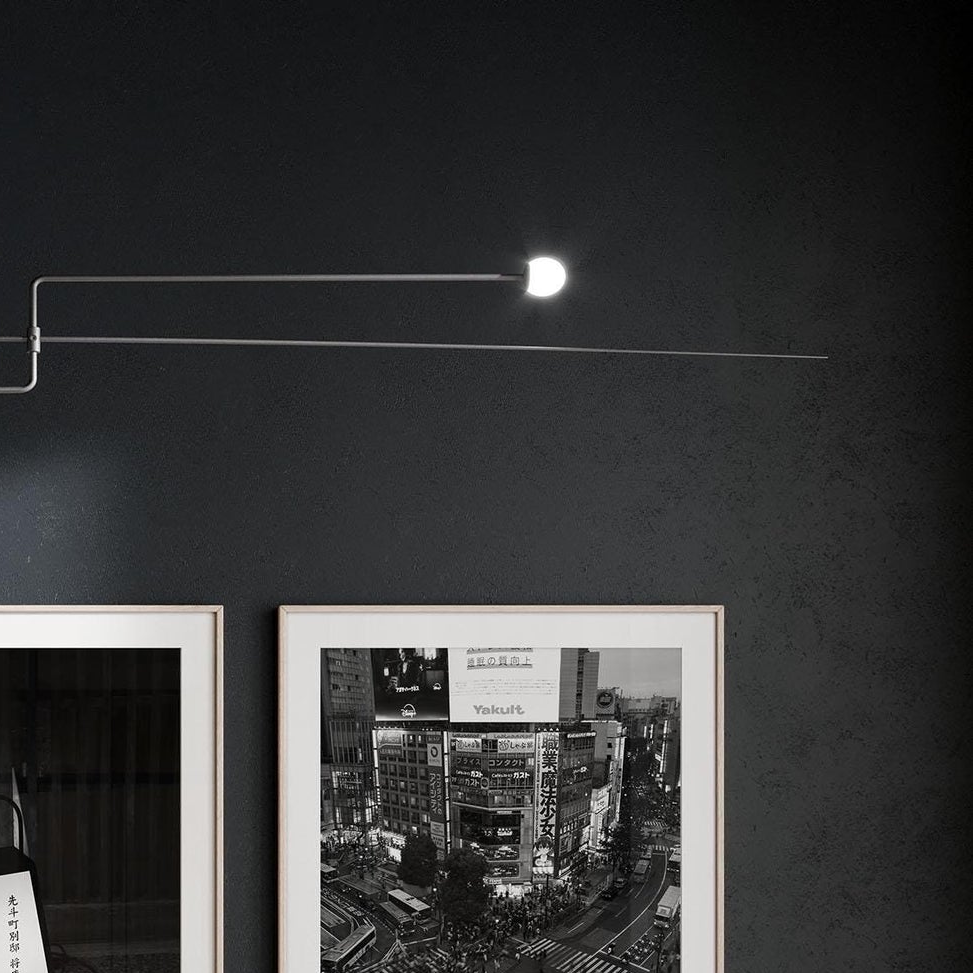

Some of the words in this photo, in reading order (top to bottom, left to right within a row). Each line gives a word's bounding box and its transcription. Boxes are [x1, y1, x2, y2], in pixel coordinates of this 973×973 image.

[473, 704, 526, 715] Yakult
[489, 758, 525, 767] コンタクト
[512, 771, 531, 779] ガスト
